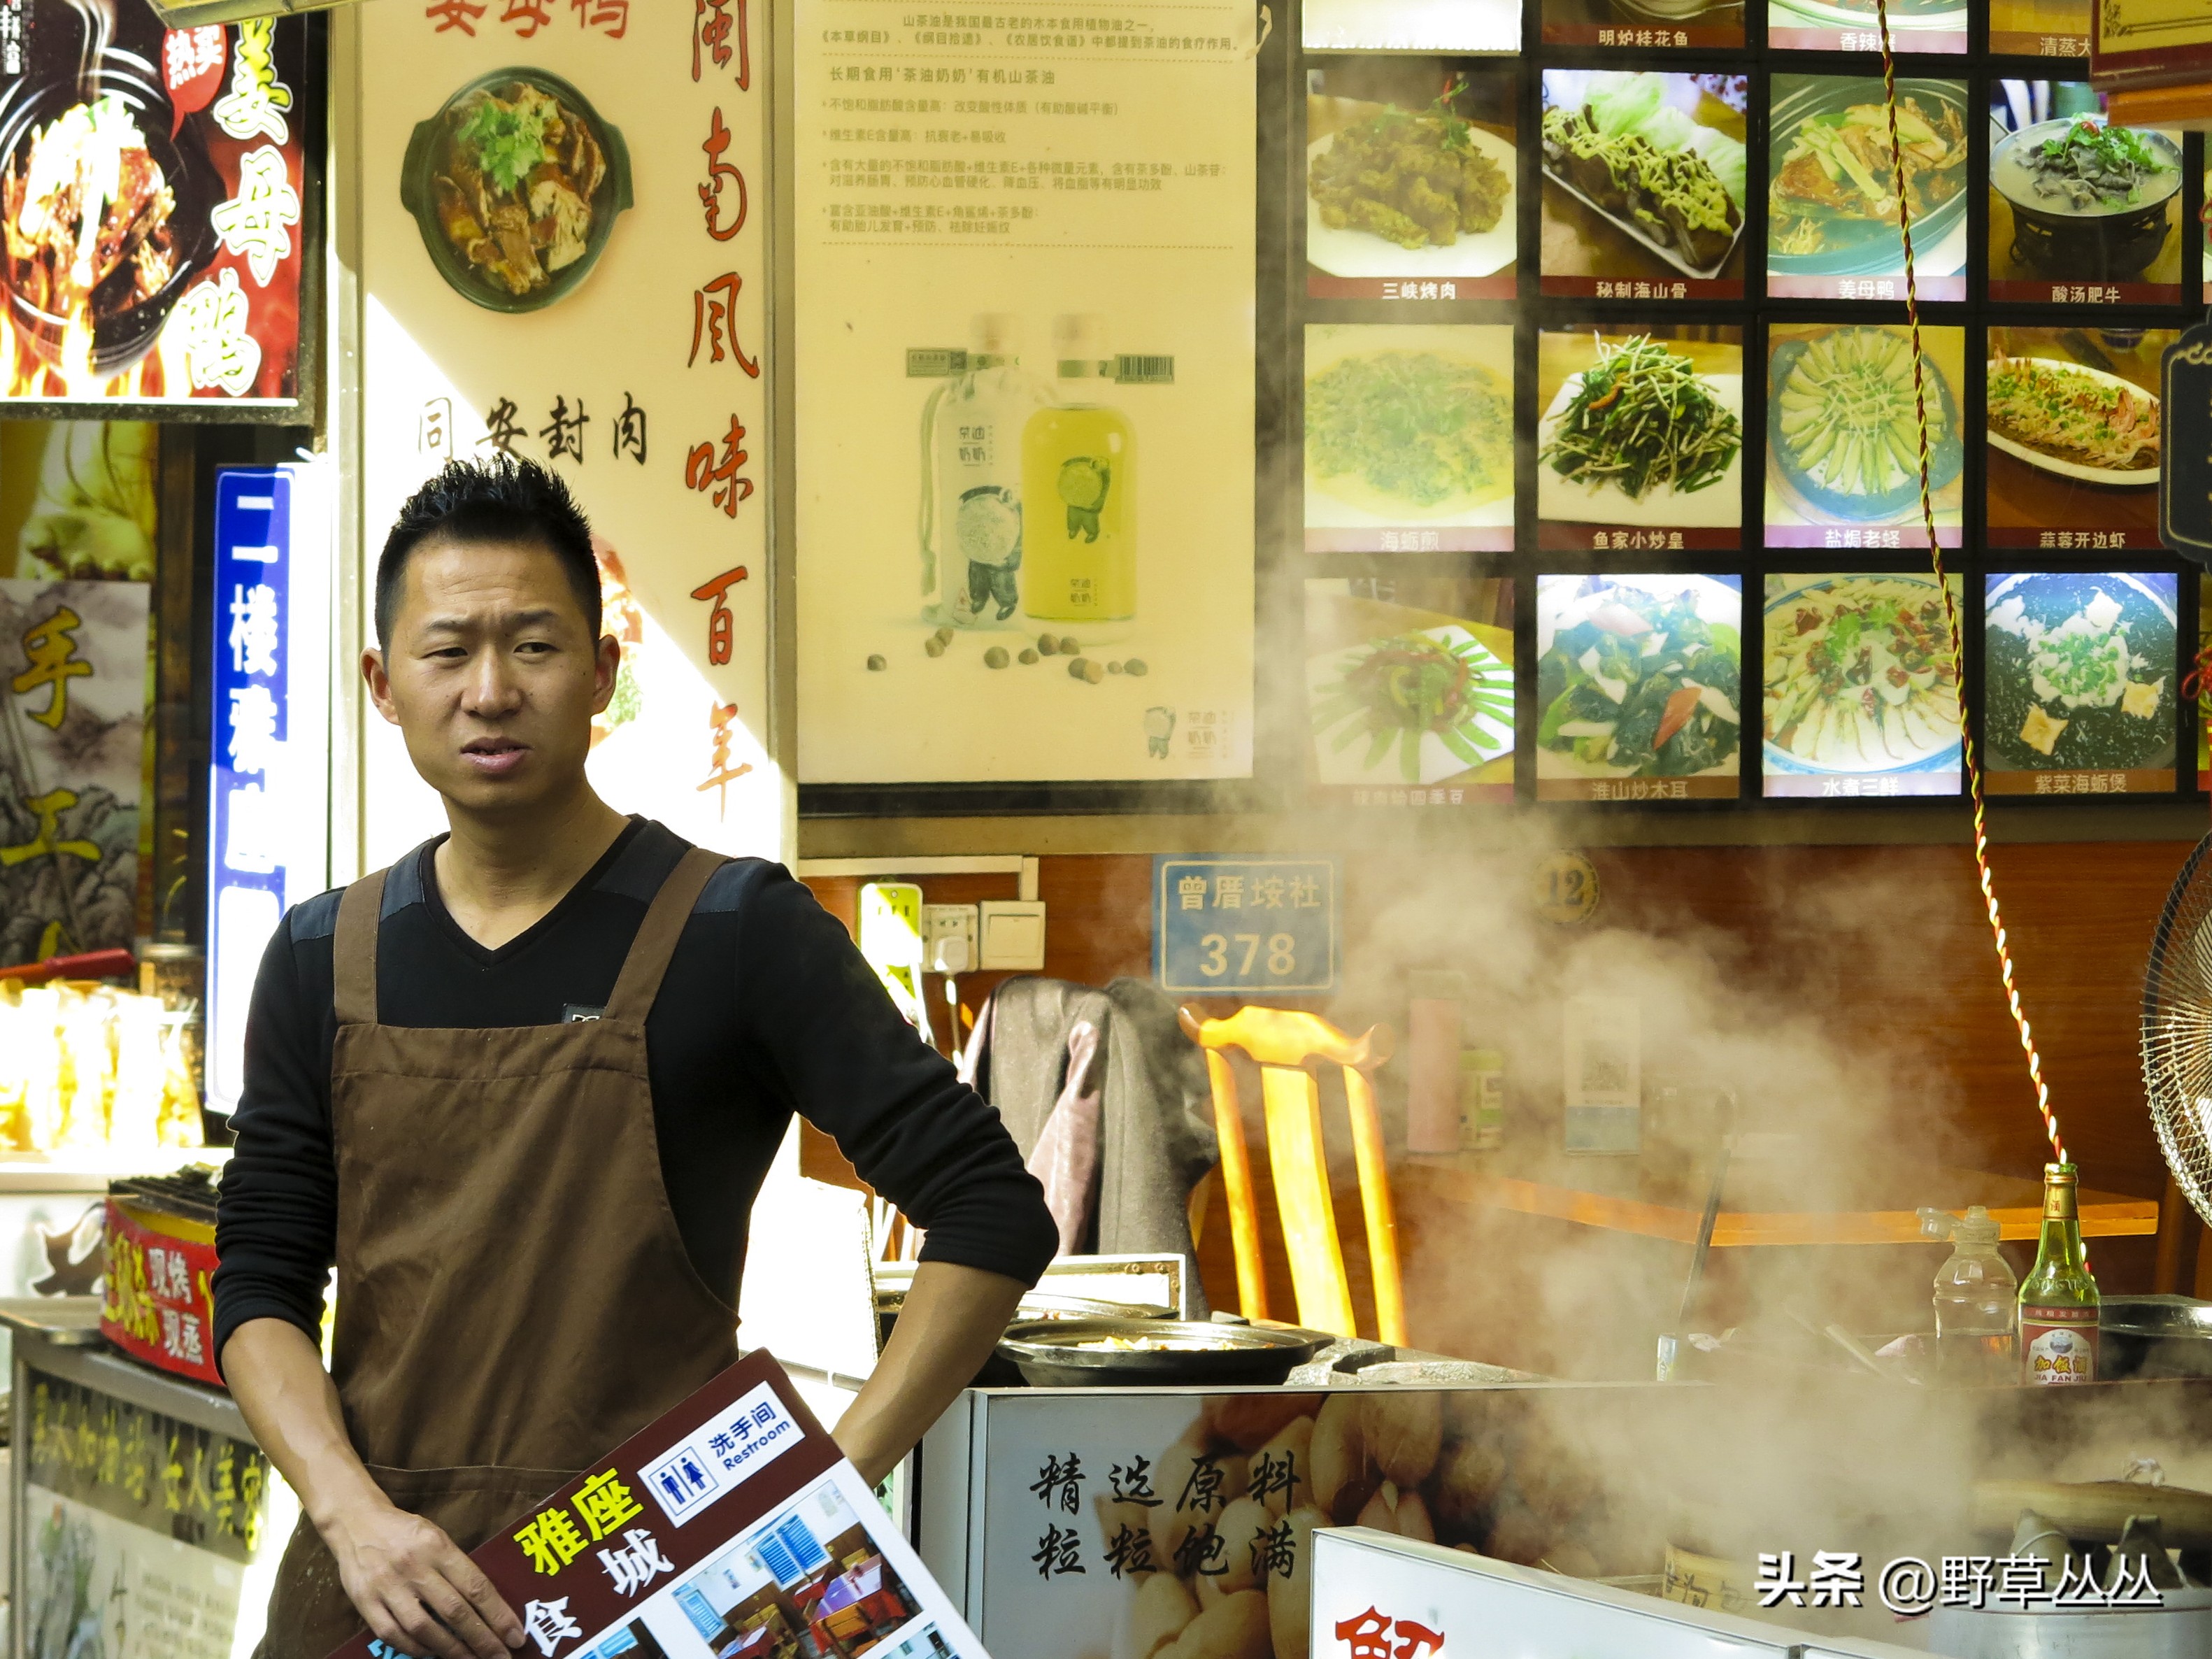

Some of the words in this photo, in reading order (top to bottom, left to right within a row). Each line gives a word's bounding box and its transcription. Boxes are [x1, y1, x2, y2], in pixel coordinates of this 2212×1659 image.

[1839, 32, 1897, 52] 香辣蟹
[1383, 282, 1457, 300] 三峡烤肉
[1839, 280, 1895, 300] 姜母鸭
[2051, 285, 2121, 304] 酸汤肥牛
[418, 390, 647, 466] 同安封肉
[1593, 531, 1685, 550] 鱼家小炒皇
[2040, 532, 2126, 550] 蒜蓉开边虾
[1547, 869, 1585, 907] 12
[1200, 933, 1296, 977] 378
[708, 1401, 776, 1458] 洗手间
[722, 1420, 791, 1471] Restroom
[1029, 1451, 1302, 1516] 精选原料
[513, 1467, 644, 1576] 雅座
[1031, 1521, 1297, 1581] 粒粒饱满
